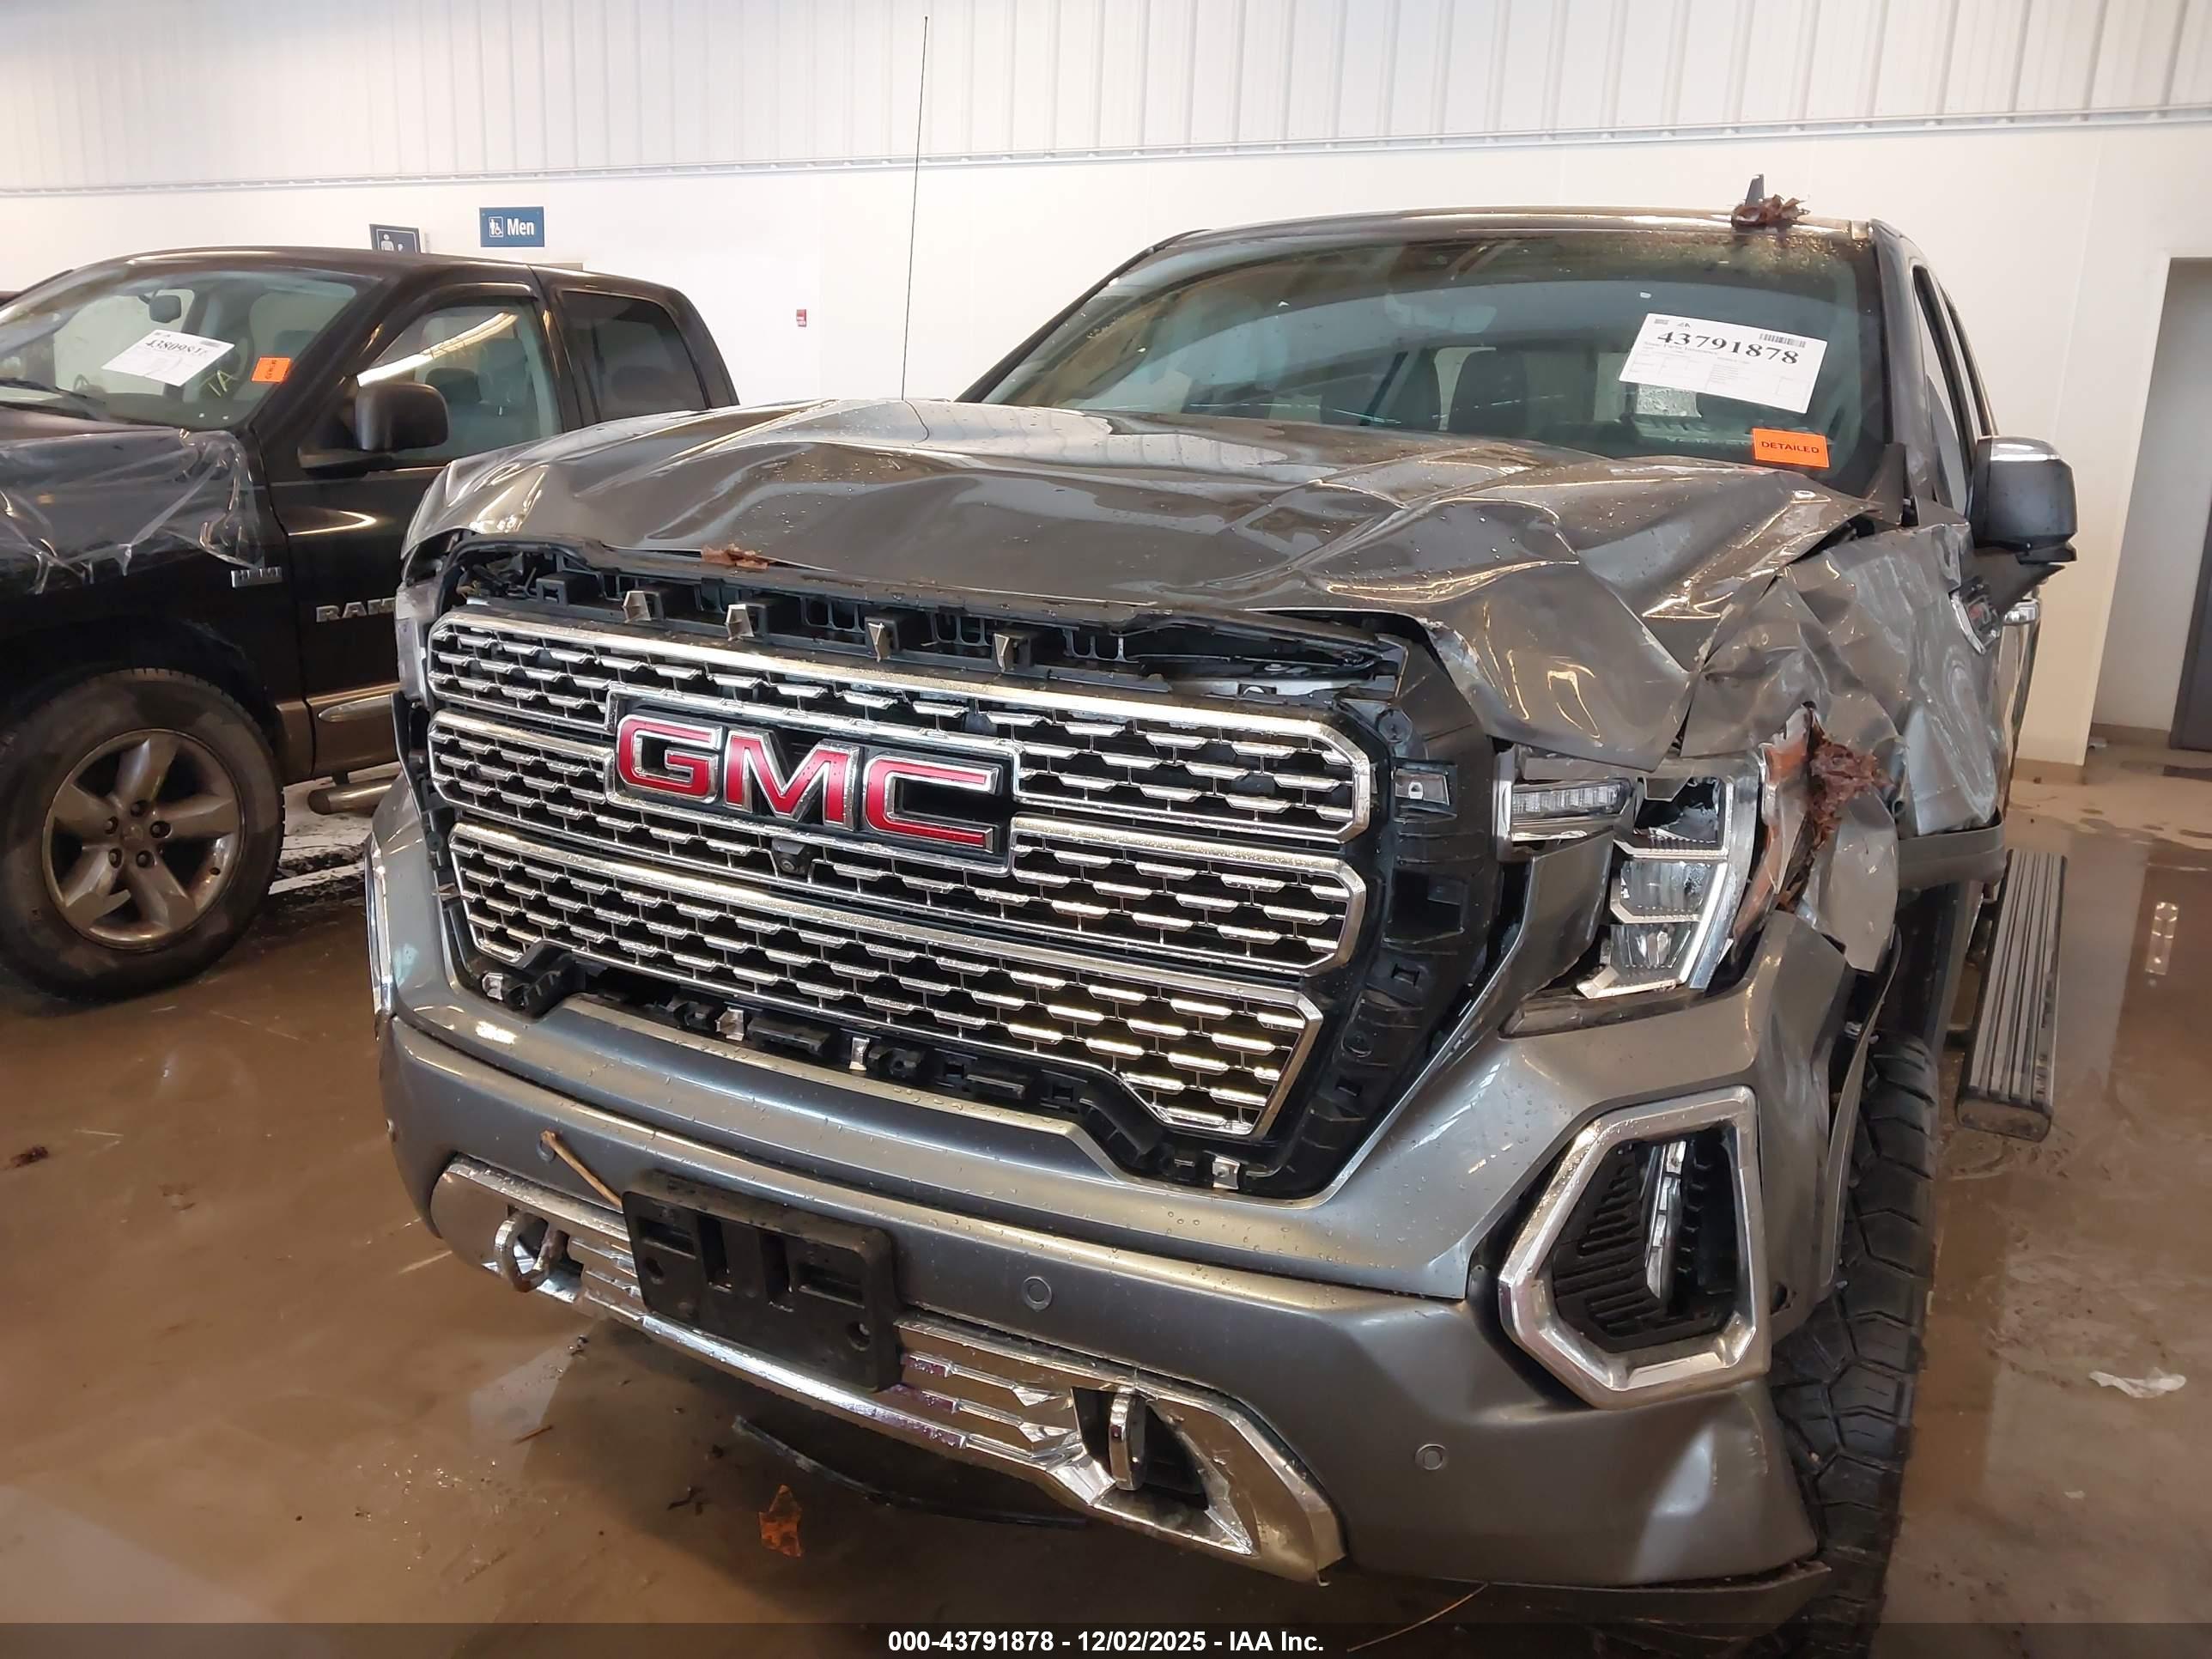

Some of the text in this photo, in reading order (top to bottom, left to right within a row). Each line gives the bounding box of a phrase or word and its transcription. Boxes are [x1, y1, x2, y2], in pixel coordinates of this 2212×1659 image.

[507, 217, 534, 236] Men
[1657, 331, 1799, 365] 43791878
[1761, 441, 1820, 455] DETAILED
[316, 597, 396, 623] RAM
[616, 714, 999, 854] GMC
